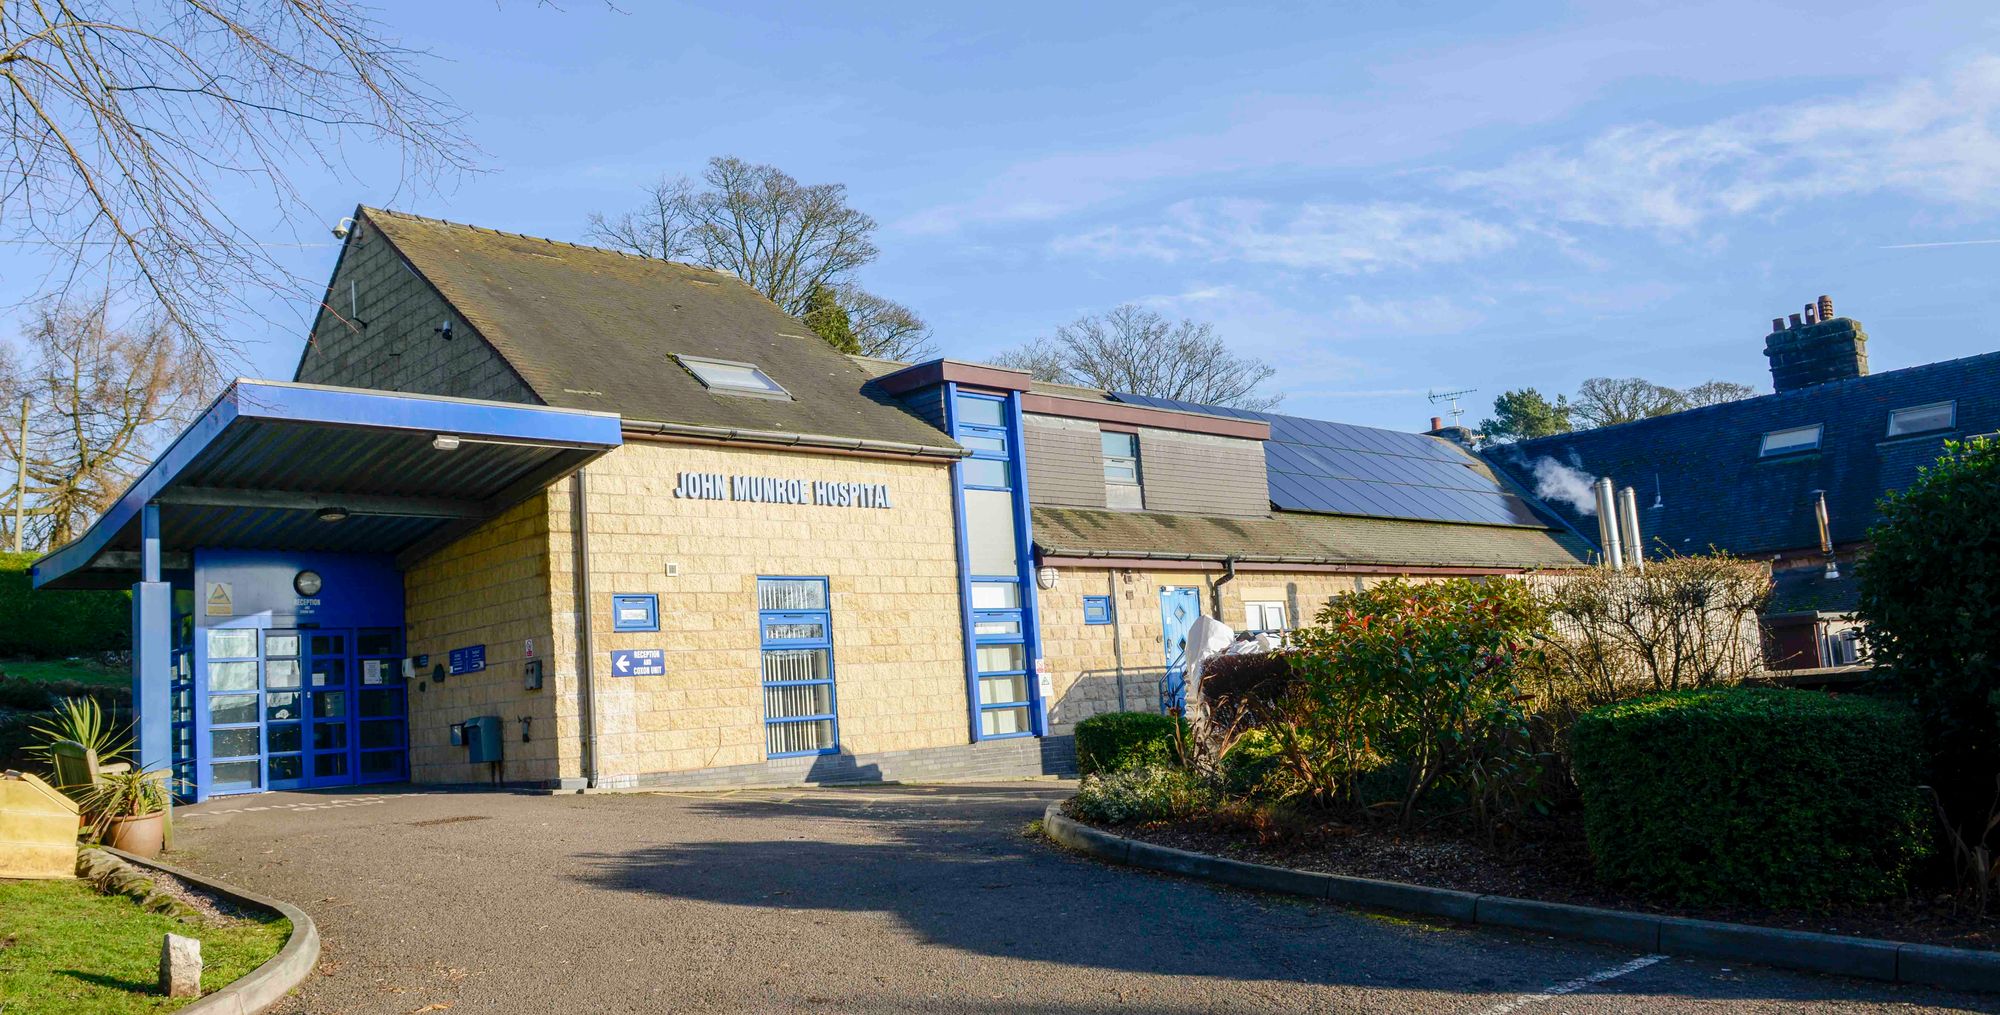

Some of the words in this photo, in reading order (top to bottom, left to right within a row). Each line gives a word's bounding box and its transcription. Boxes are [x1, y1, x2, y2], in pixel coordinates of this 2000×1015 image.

[674, 472, 726, 500] JOHN
[731, 475, 808, 504] MUNROE
[813, 480, 892, 508] HOSPITAL
[295, 598, 321, 606] RECEPTION
[633, 650, 660, 658] RECEPTION
[650, 666, 662, 674] UNIT
